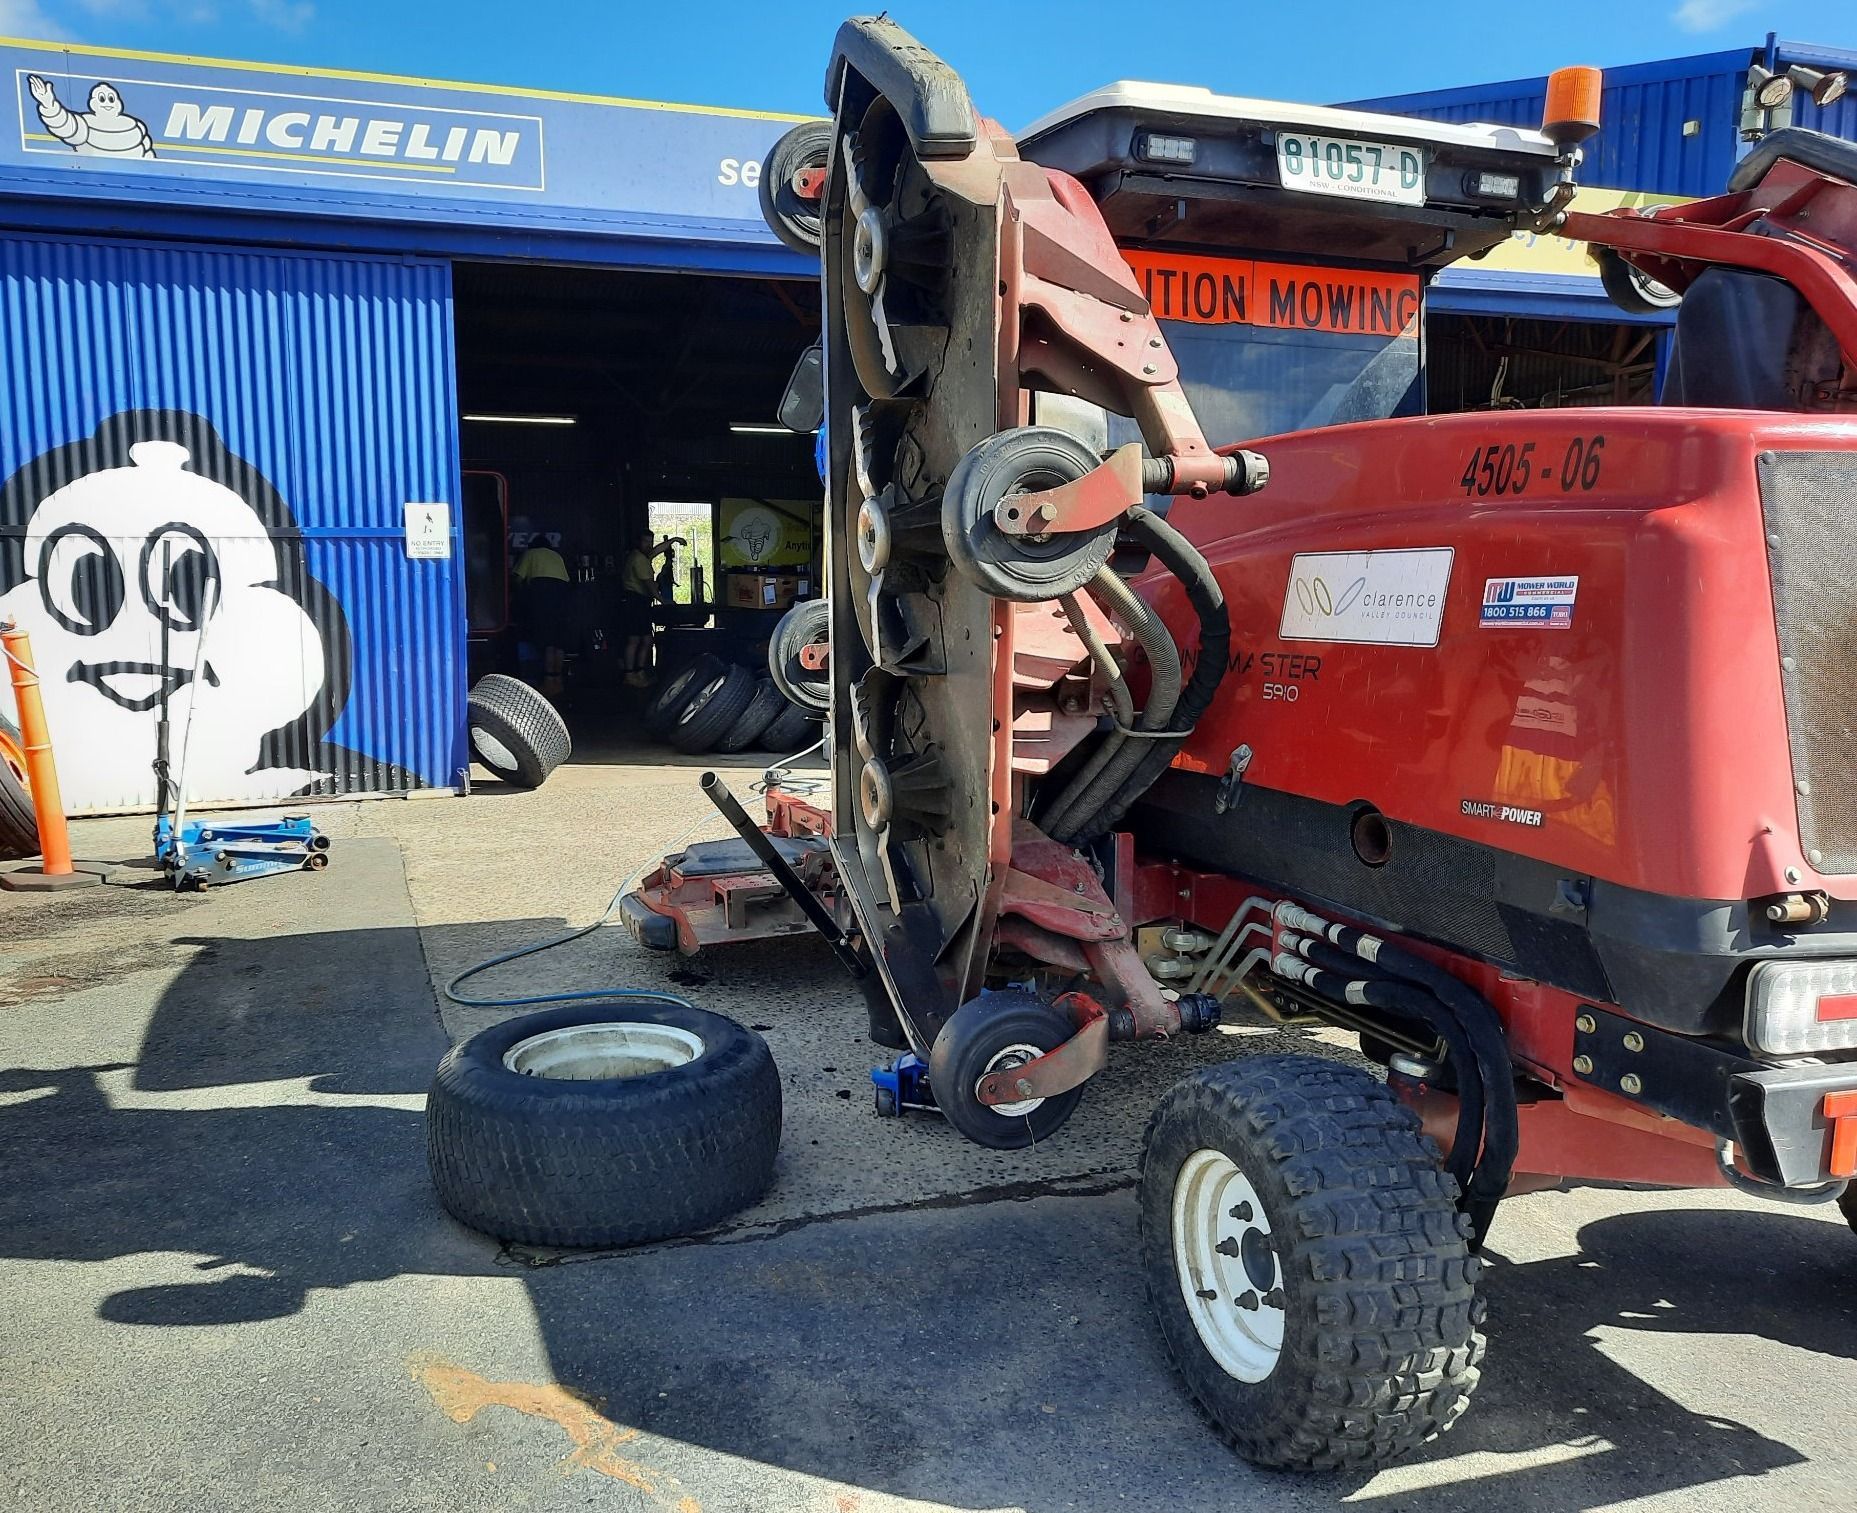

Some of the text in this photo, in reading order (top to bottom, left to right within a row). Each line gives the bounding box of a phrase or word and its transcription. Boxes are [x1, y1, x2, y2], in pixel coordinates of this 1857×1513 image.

[163, 102, 520, 165] MICHELIN
[717, 158, 762, 188] se
[1284, 137, 1419, 189] 81057 D
[1309, 180, 1330, 190] NSW
[1337, 184, 1398, 198] CONDITIONAL
[1269, 278, 1418, 334] MOWING
[1460, 435, 1605, 497] 4505 - 06
[1363, 590, 1436, 608] clarence
[1516, 581, 1575, 590] MOWER WORLD
[1361, 611, 1433, 620] VALLEY COUNCIL
[1483, 606, 1547, 617] 1800 515 866
[1461, 800, 1542, 827] SMART POWER
